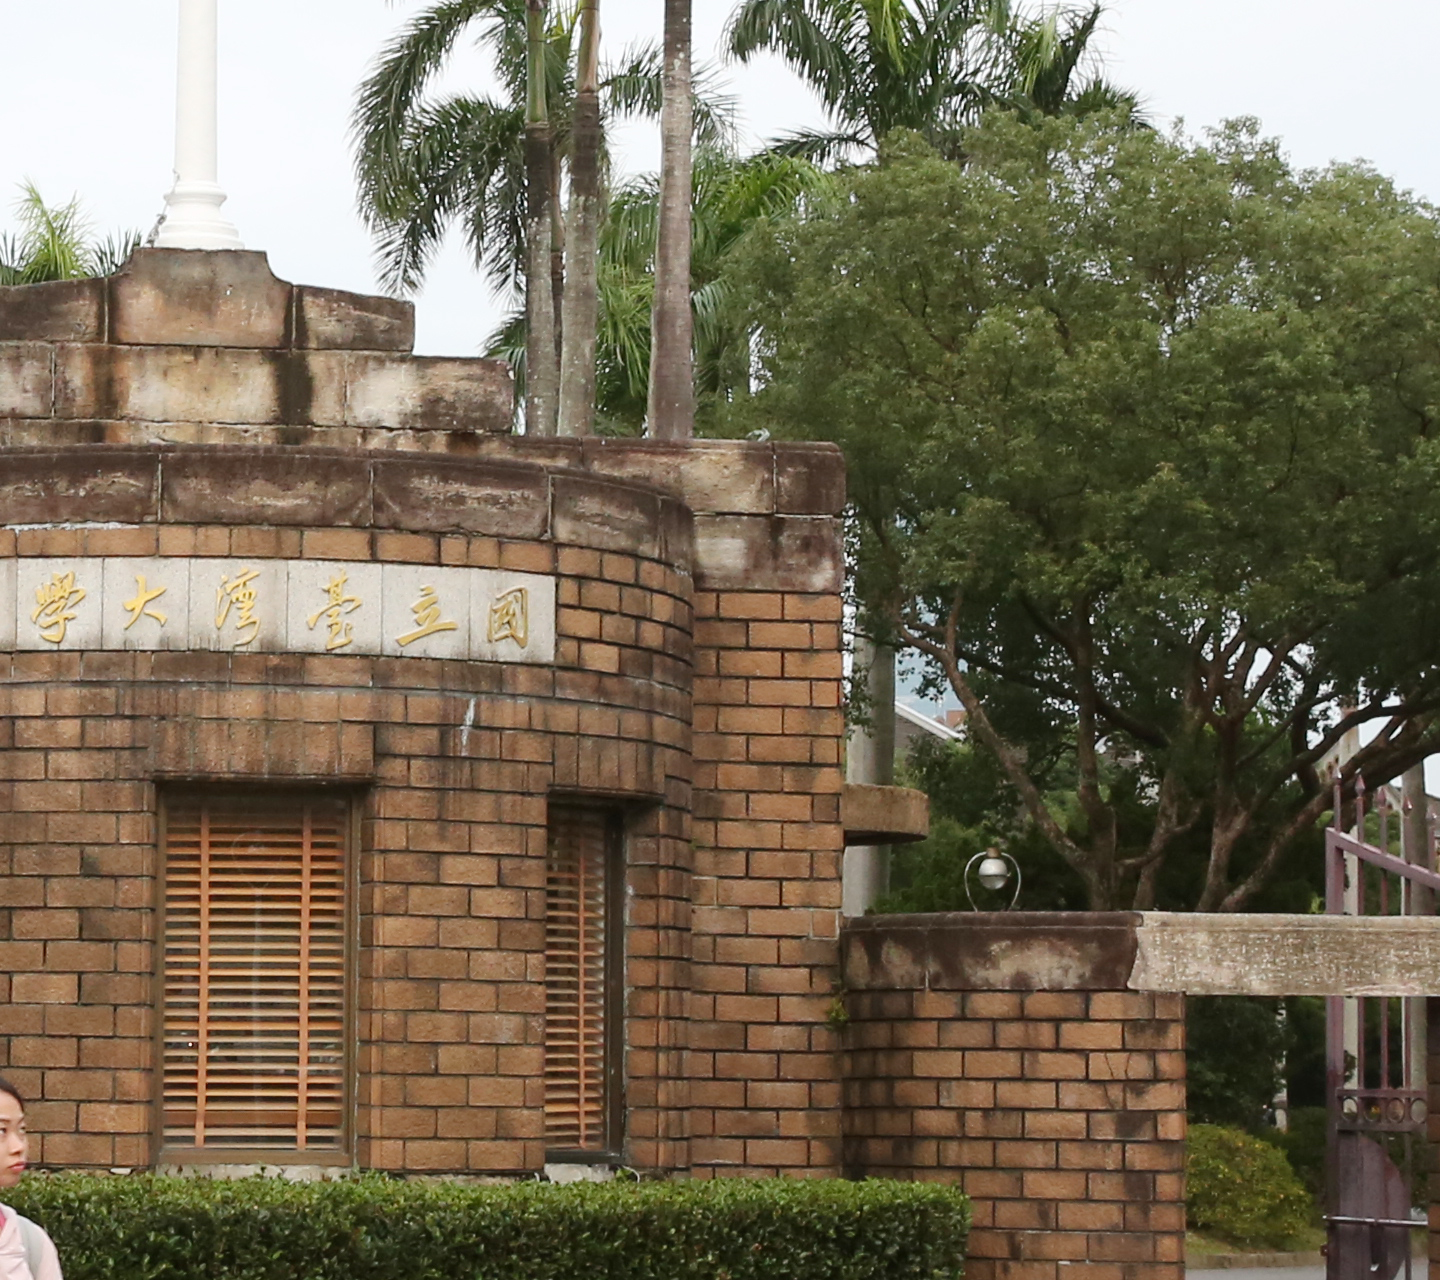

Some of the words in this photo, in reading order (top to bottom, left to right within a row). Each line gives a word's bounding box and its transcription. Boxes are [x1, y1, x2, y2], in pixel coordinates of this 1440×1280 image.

[31, 567, 529, 650] 國立臺灣大學
